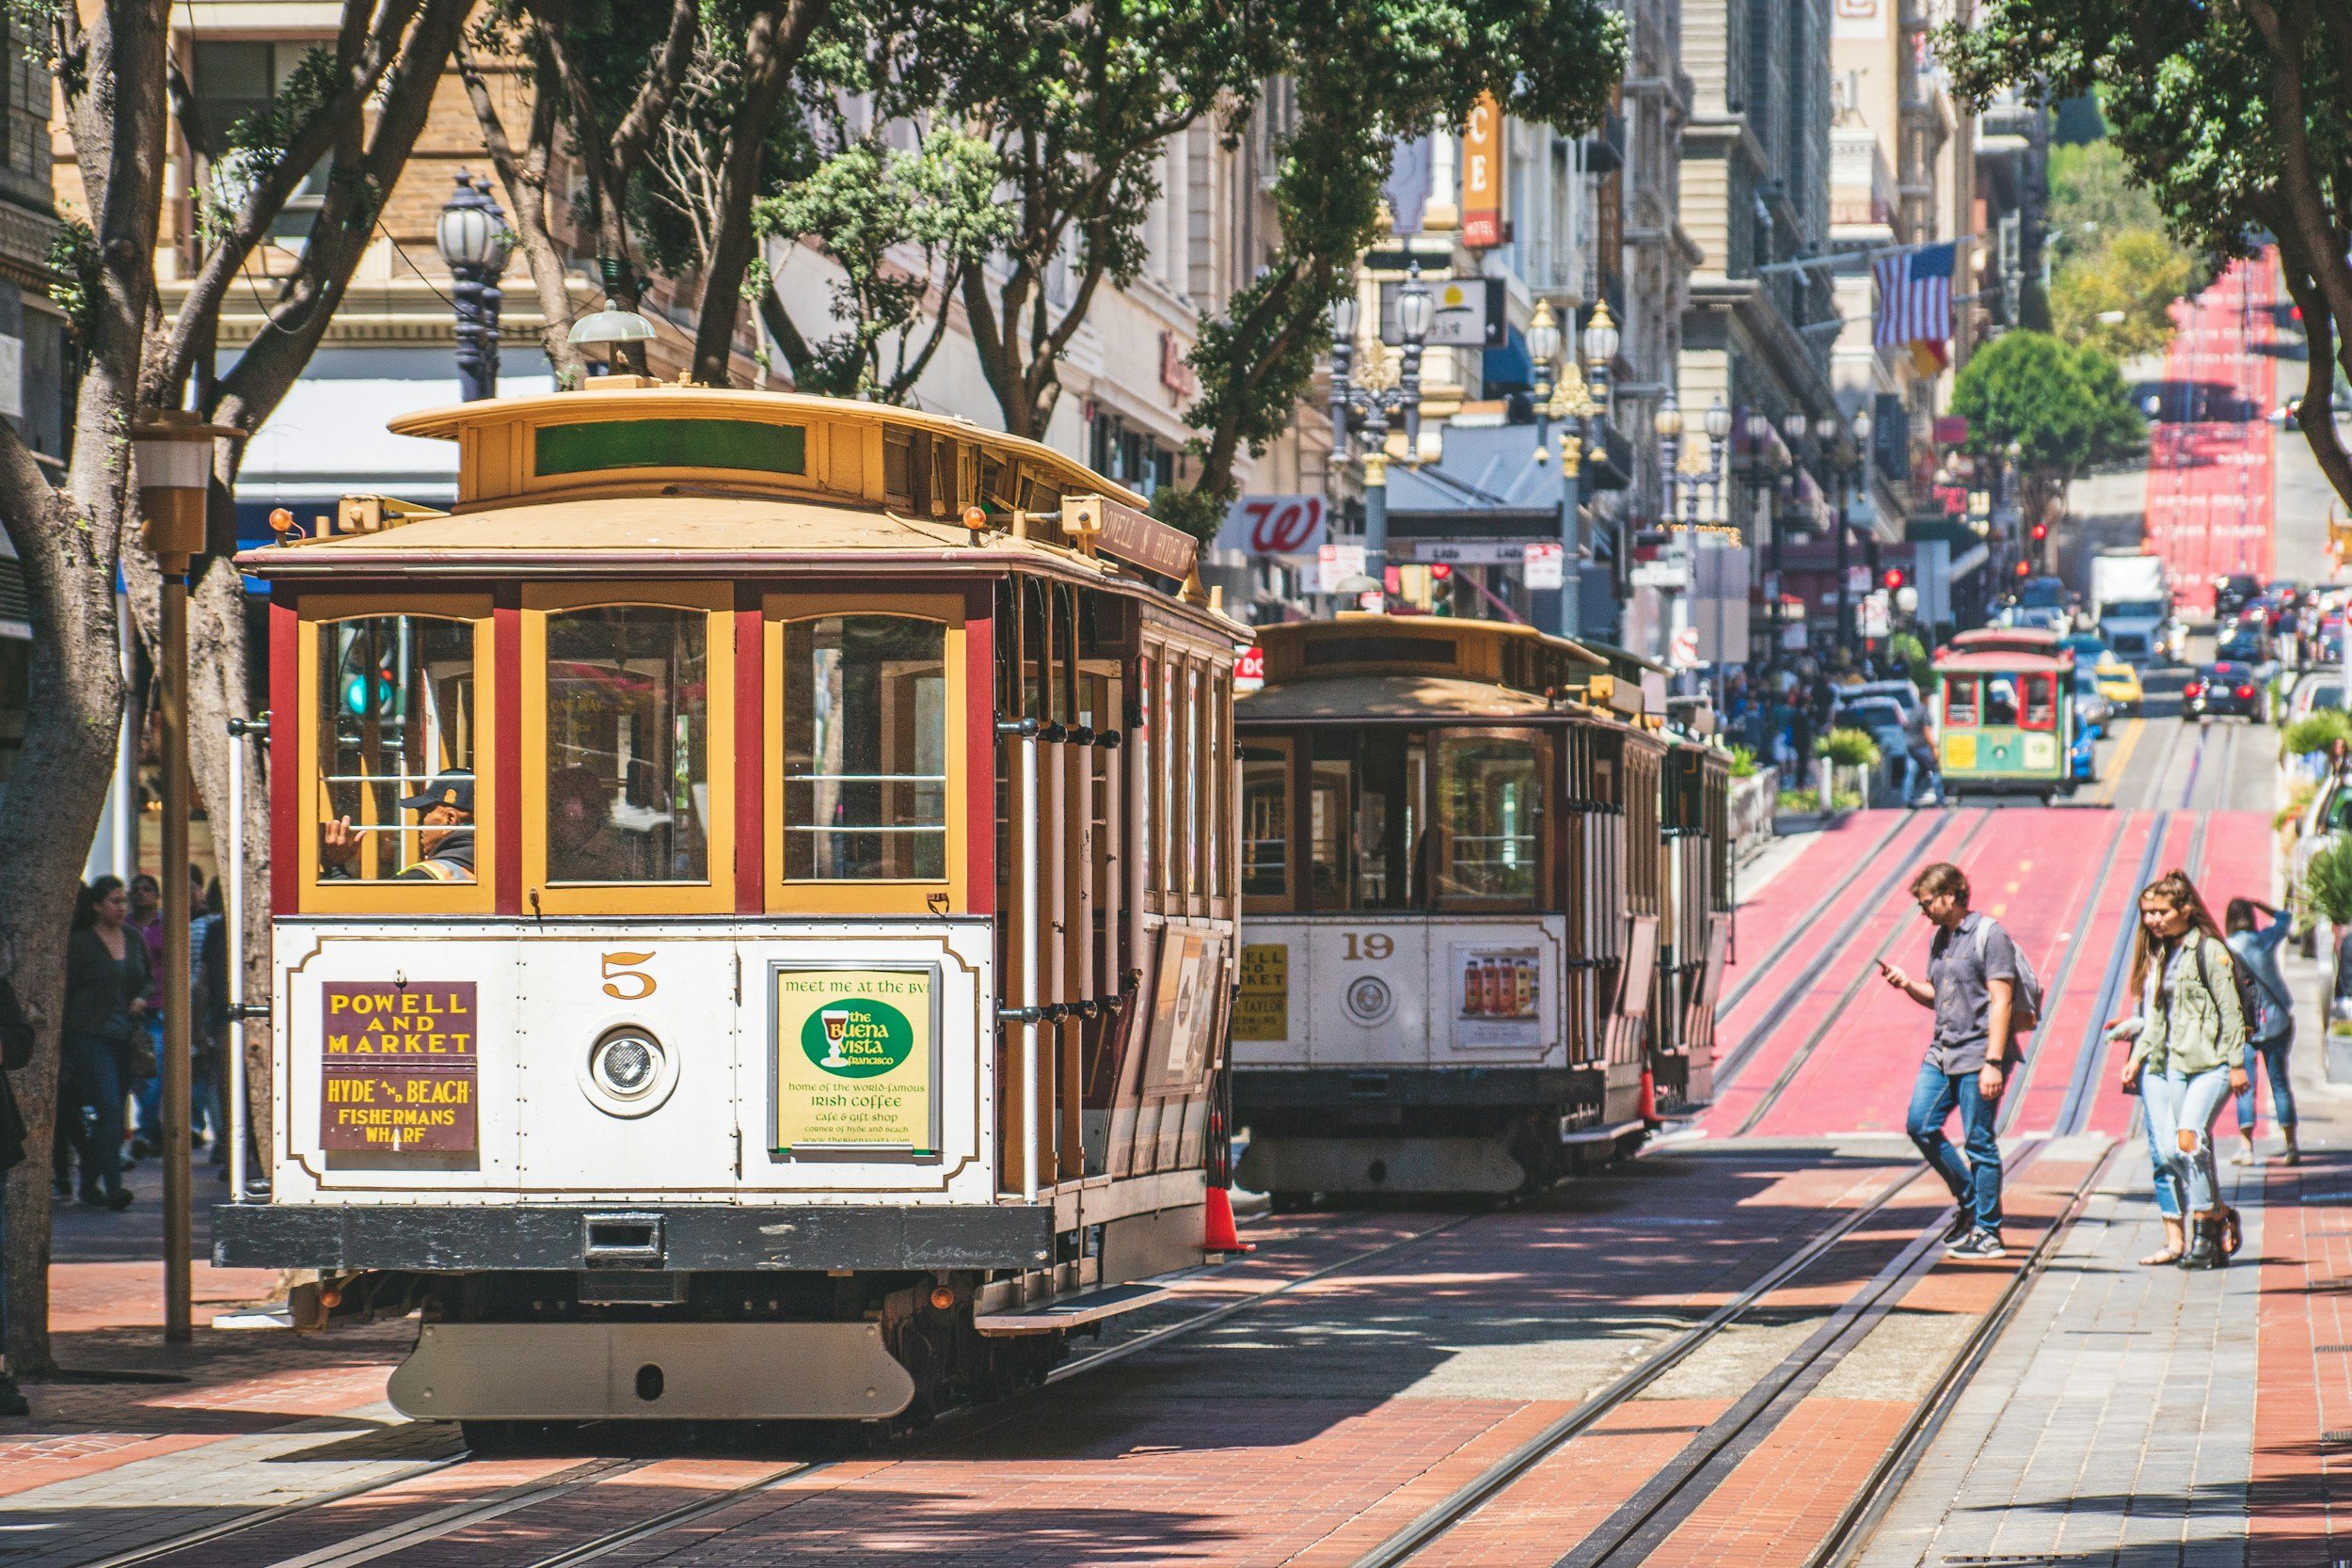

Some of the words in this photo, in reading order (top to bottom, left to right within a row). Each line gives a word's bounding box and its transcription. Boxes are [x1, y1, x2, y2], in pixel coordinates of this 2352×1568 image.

[1245, 497, 1321, 552] W
[1152, 532, 1180, 565] HYDE
[1342, 932, 1394, 960] 19
[1246, 952, 1283, 963] ELL
[601, 951, 657, 1000] 5
[1241, 964, 1263, 973] ND
[786, 980, 825, 992] meet
[830, 981, 852, 992] me
[857, 981, 873, 993] at
[877, 979, 904, 993] the
[1240, 974, 1283, 986] KET
[330, 993, 468, 1014] POWELL
[366, 1016, 435, 1032] AND
[848, 1011, 871, 1022] the
[328, 1034, 470, 1053] MARKET
[327, 1079, 375, 1102] HYDE
[380, 1080, 404, 1103] AND
[406, 1080, 469, 1103] BEACH
[788, 1083, 817, 1091] home
[819, 1083, 830, 1093] of
[833, 1083, 850, 1091] the
[339, 1108, 454, 1126] FISHERMANS
[840, 1113, 848, 1121] &
[871, 1113, 898, 1123] shop
[365, 1127, 426, 1143] WHARF
